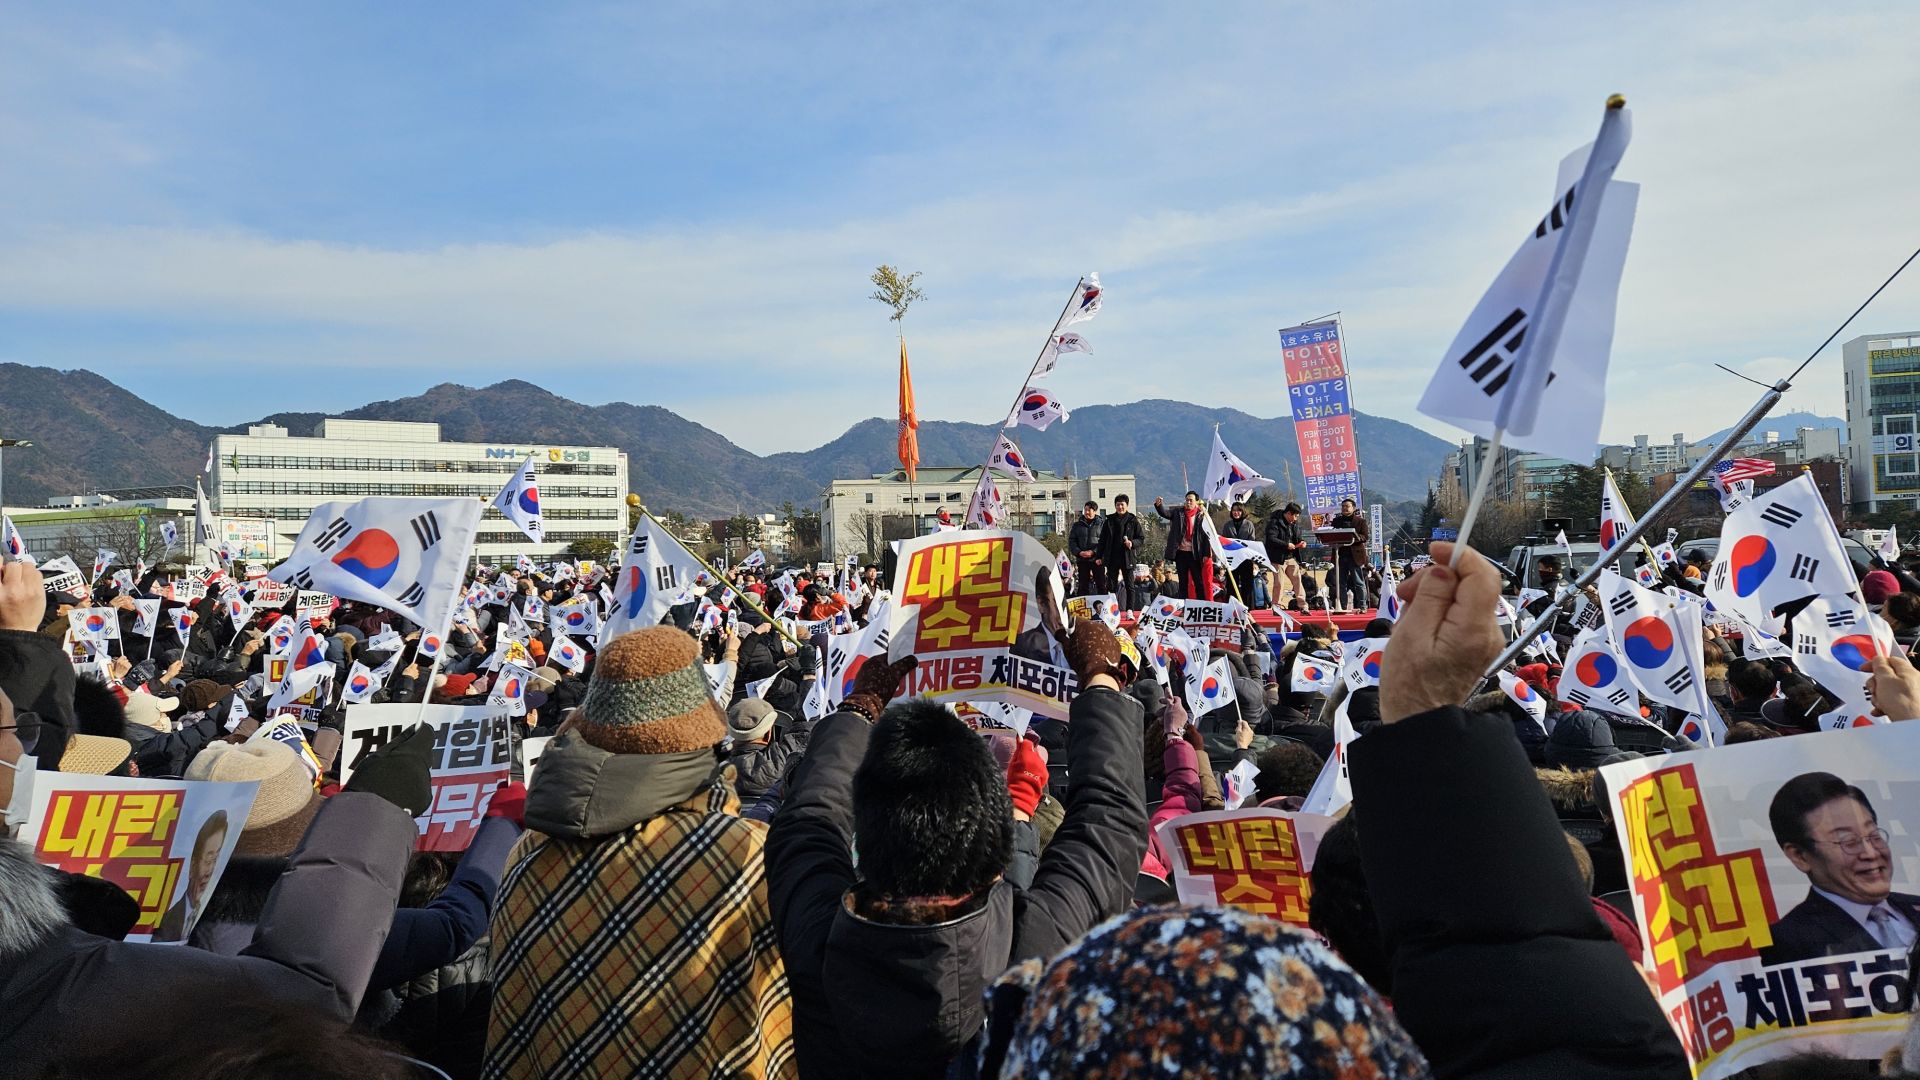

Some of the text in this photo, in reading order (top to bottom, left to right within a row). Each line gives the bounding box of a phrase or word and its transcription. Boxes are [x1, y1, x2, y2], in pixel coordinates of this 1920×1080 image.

[485, 448, 590, 462] NH 농협
[259, 591, 292, 602] 사퇴하
[904, 539, 1010, 600] 내란
[298, 593, 335, 607] 계엄합
[920, 593, 1026, 650] 수괴
[42, 793, 180, 860] 내란
[1182, 818, 1298, 871] 내란
[1620, 771, 1703, 882] 내란
[83, 858, 180, 929] 괴
[1648, 856, 1775, 979] 수괴
